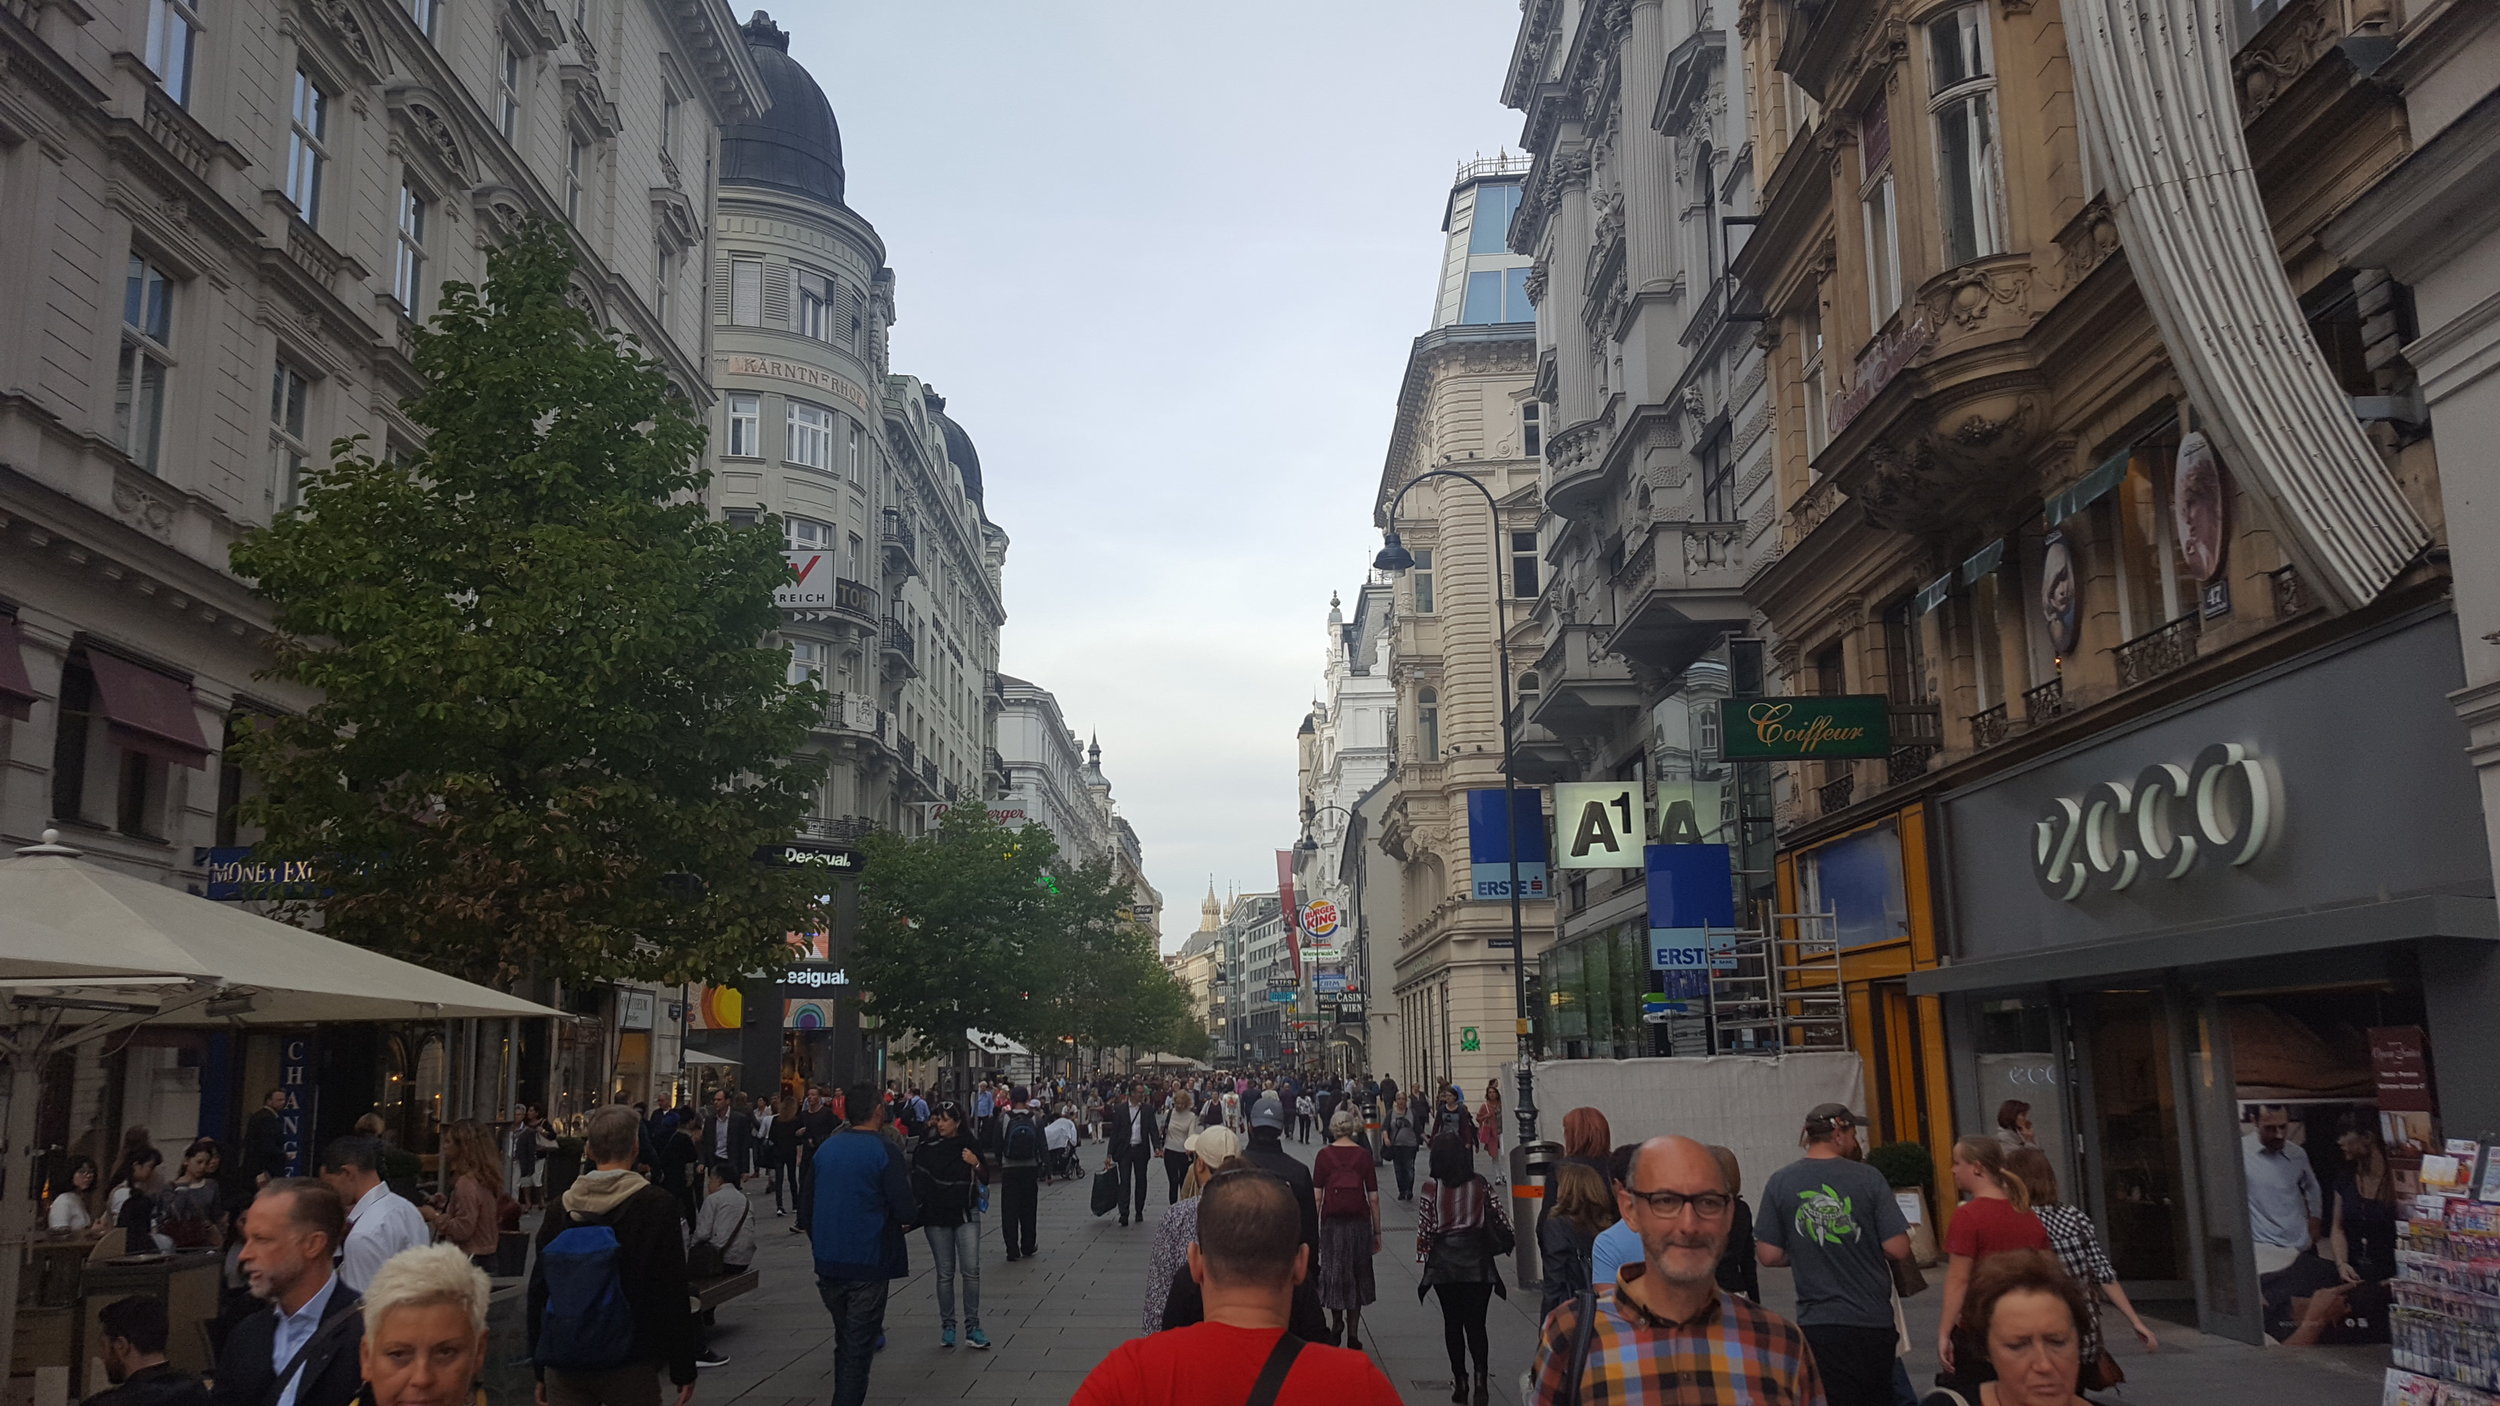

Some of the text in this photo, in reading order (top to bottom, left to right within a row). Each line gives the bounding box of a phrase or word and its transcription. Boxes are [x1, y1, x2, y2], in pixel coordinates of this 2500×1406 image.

[2207, 585, 2221, 605] 47
[1747, 702, 1863, 753] Coiffeur
[2028, 742, 2269, 901] ecco
[1478, 880, 1527, 896] ERSE
[1305, 905, 1335, 920] BURGER
[1342, 1003, 1362, 1012] WIEN
